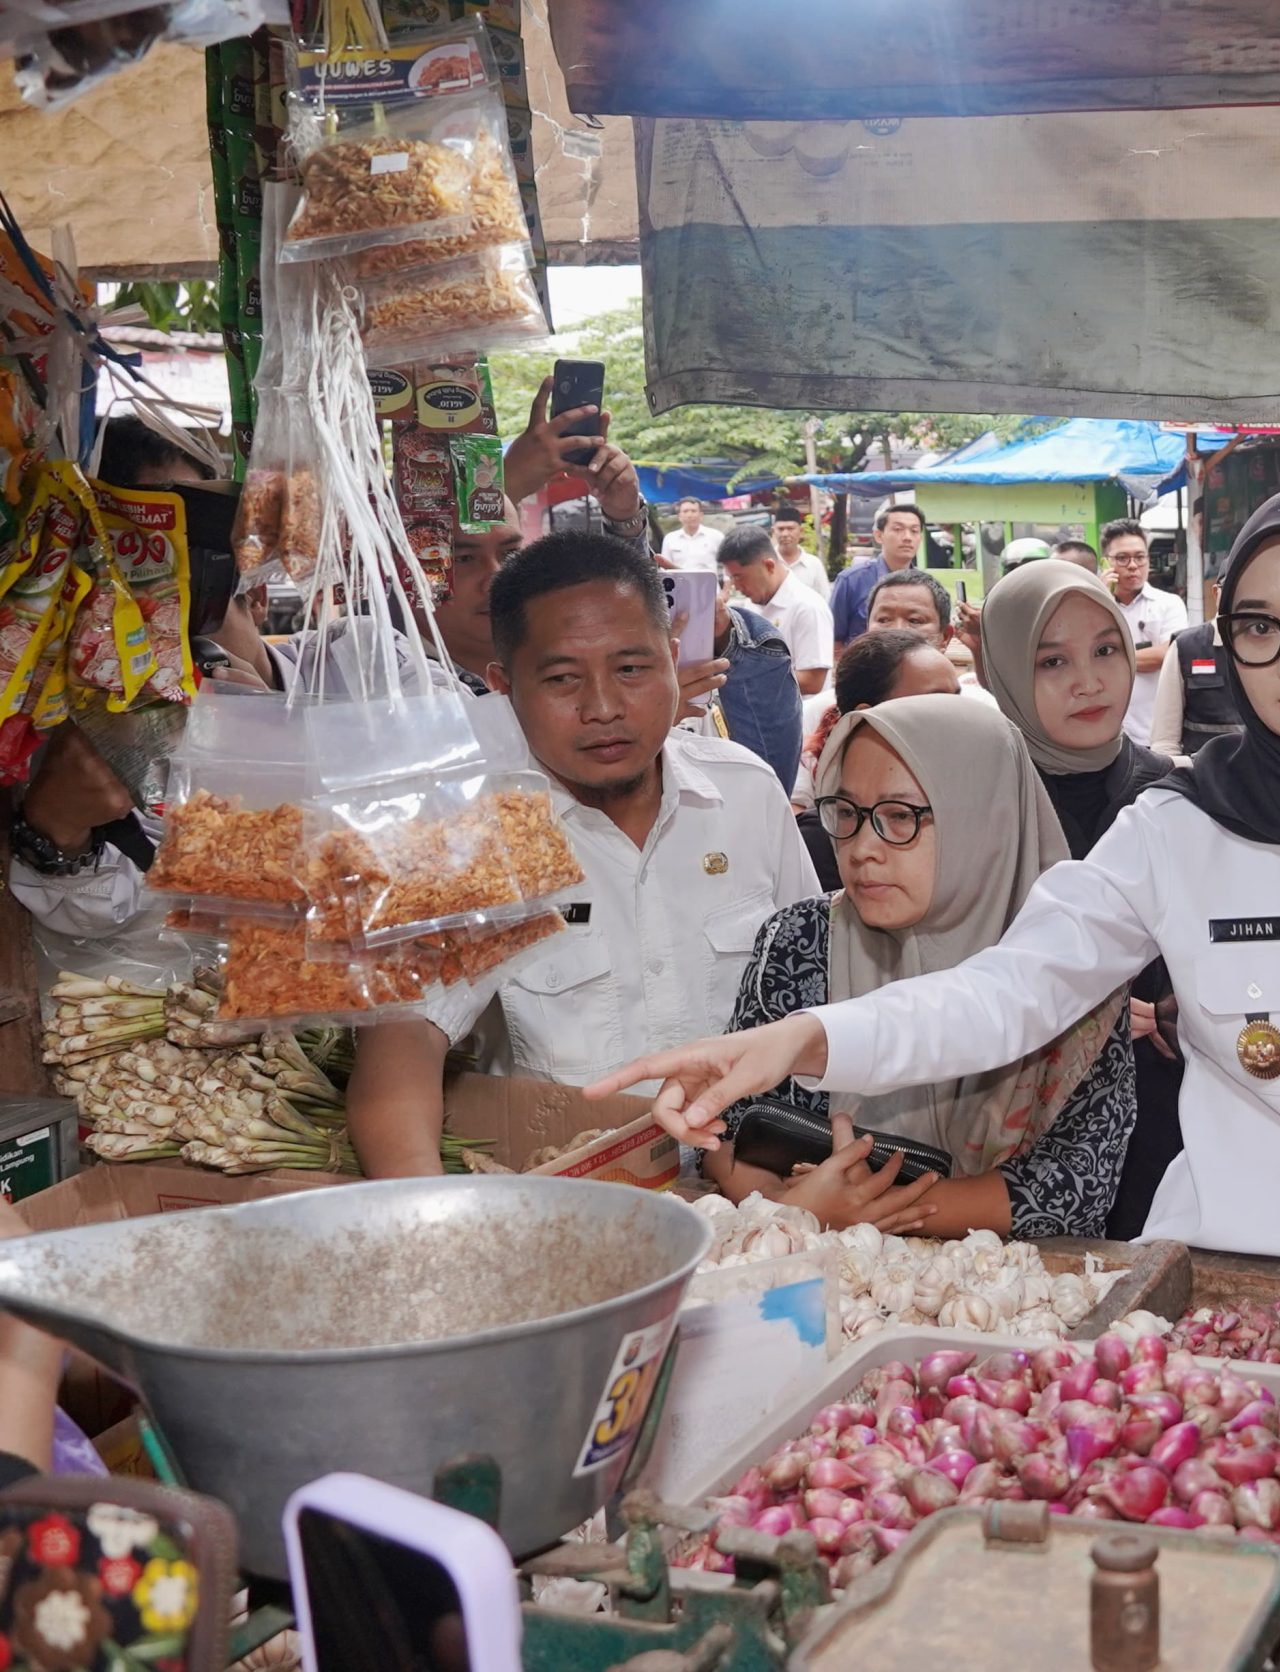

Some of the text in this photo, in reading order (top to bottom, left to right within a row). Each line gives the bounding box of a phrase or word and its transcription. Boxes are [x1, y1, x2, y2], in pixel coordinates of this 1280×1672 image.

[372, 385, 394, 394] AGLI
[440, 400, 465, 408] AGLIO
[1230, 922, 1274, 936] JIHAN
